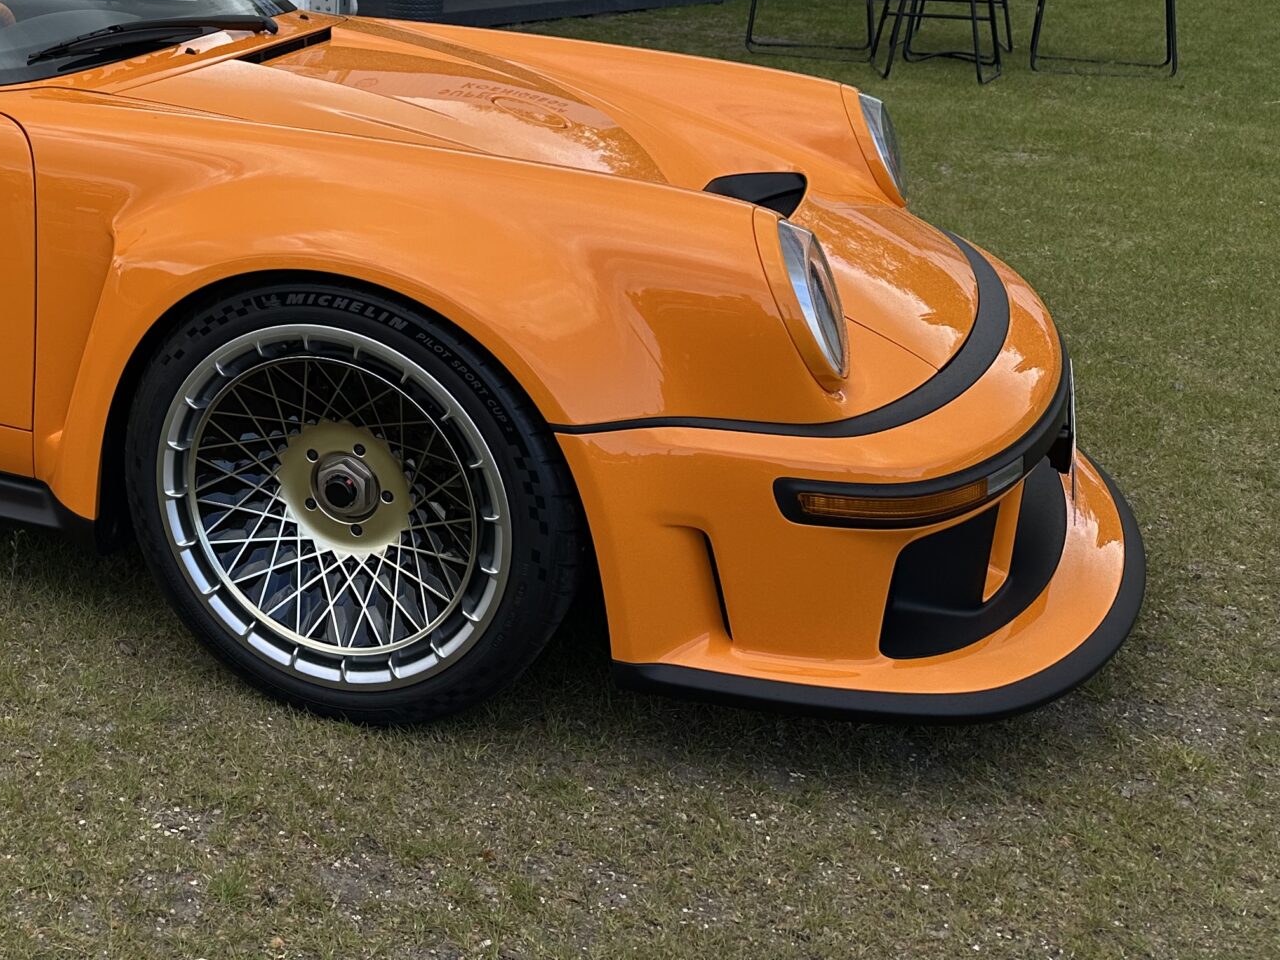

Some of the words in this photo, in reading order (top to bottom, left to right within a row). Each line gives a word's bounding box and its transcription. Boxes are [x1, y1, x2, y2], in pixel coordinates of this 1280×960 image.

[285, 292, 410, 330] MICHELIN
[415, 332, 453, 358] PILOT
[451, 359, 489, 395] SPORT
[487, 399, 508, 423] CUP
